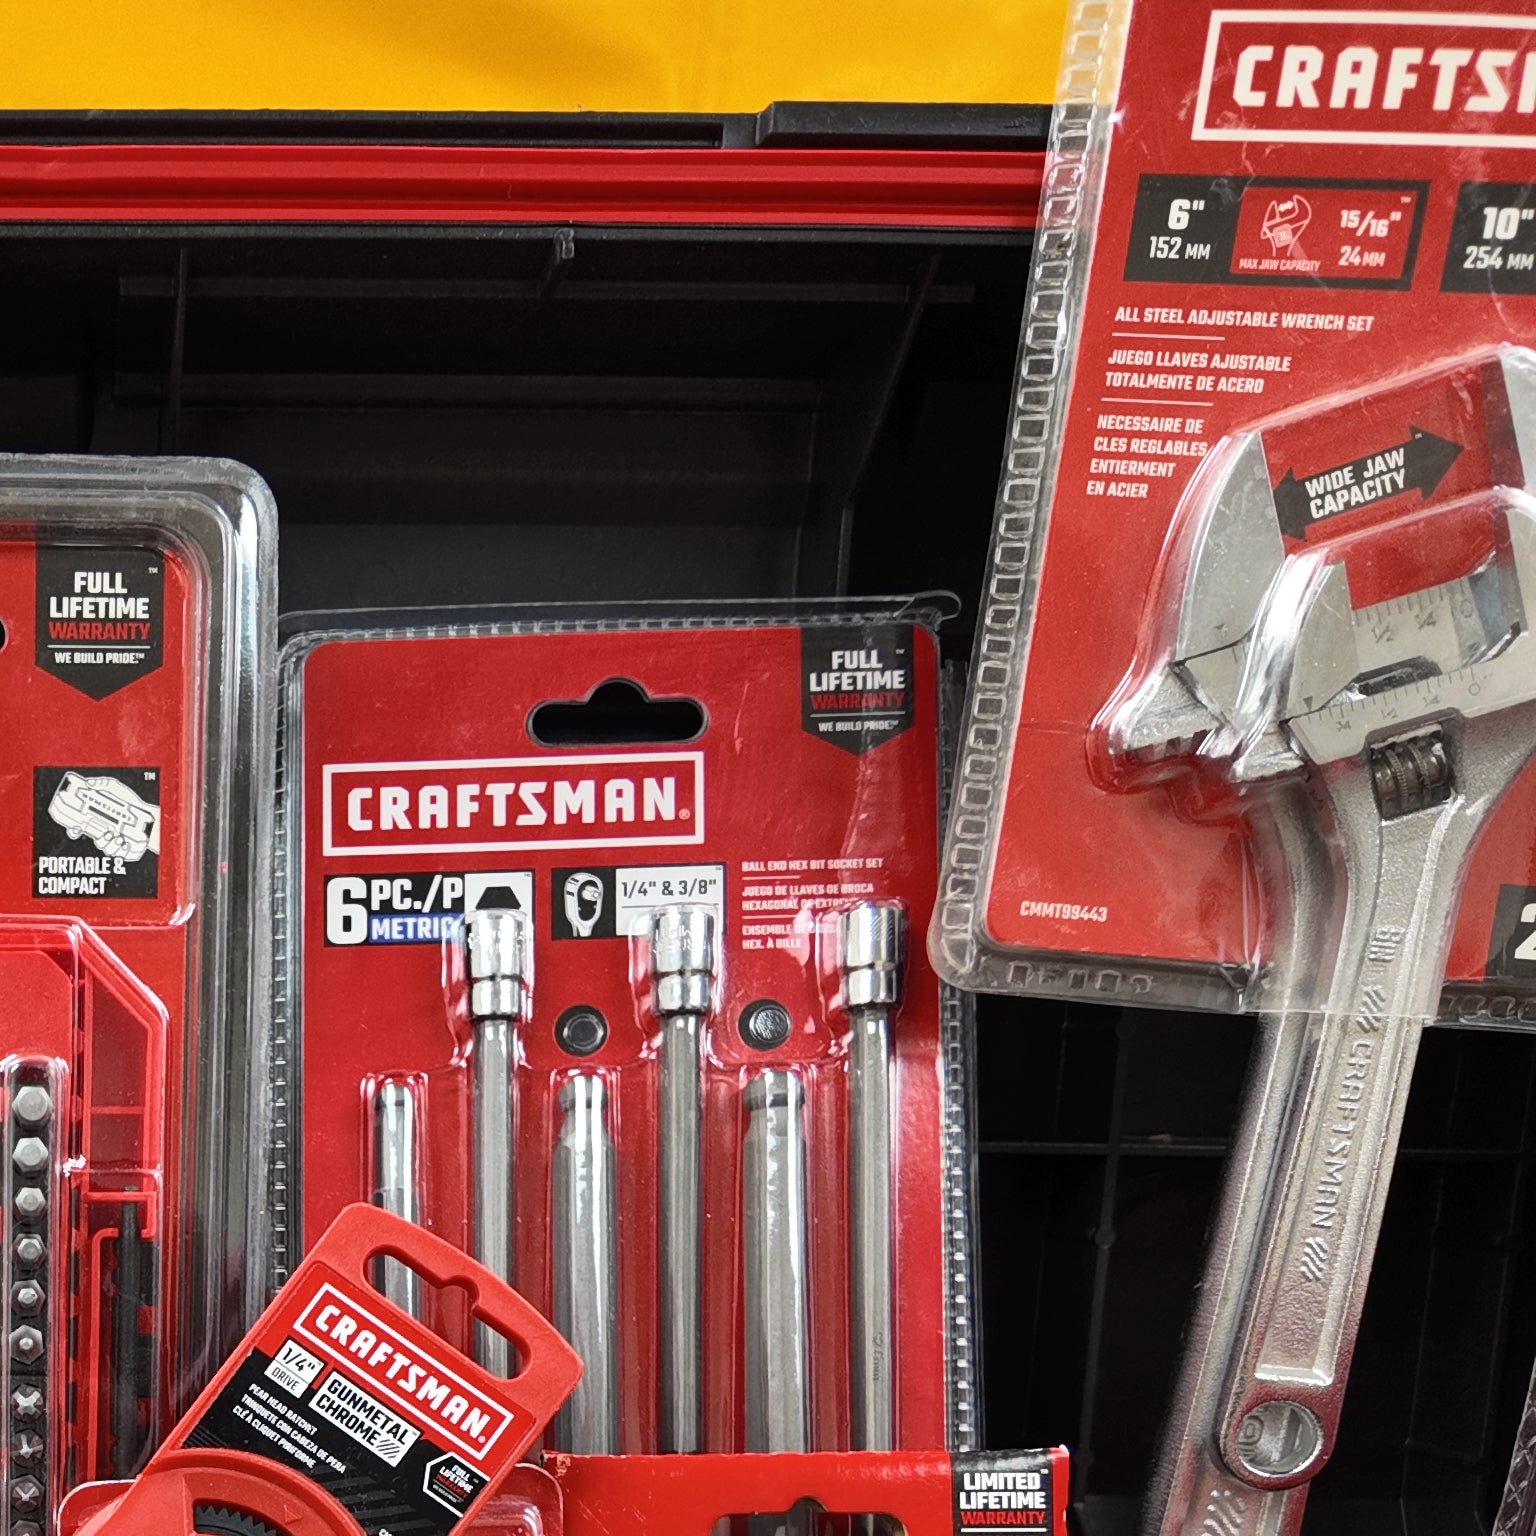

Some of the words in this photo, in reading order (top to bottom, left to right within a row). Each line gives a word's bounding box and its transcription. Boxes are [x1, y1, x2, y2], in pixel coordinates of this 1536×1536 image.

[1150, 237, 1180, 259] 152
[1186, 244, 1210, 260] MM
[1339, 246, 1361, 266] 24
[1363, 253, 1385, 267] MM
[1464, 246, 1503, 269] 254
[1508, 254, 1534, 270] MM
[1115, 306, 1140, 322] ALL
[1144, 308, 1184, 324] STEEL
[1187, 309, 1279, 327] ADJUSTABLE
[1282, 313, 1344, 330] WRENCH
[1347, 315, 1374, 331] SET
[1108, 350, 1153, 365] JUEGO
[1156, 352, 1208, 368] LLAVES
[1211, 353, 1291, 372] AJUSTABLE
[1106, 372, 1193, 389] TOTALMENTE
[1196, 375, 1214, 391] DE
[1217, 377, 1264, 394] ACERO
[1097, 415, 1181, 432] NECESSAIRE
[1185, 419, 1204, 434] DE
[1305, 465, 1354, 499] WIDE
[1362, 448, 1404, 480] JAW
[1310, 469, 1405, 520] CAPACITY
[74, 572, 127, 593] FULL
[50, 598, 149, 619] LIFETIME
[49, 622, 151, 640] WARRANTY
[832, 650, 883, 670] FULL
[810, 670, 905, 692] LIFETIME
[39, 857, 110, 874] PORTABLE
[113, 858, 126, 874] &
[742, 861, 766, 872] BALL
[768, 861, 786, 871] END
[789, 860, 808, 870] HEX
[810, 859, 825, 870] BIT
[828, 858, 863, 869] SOCKET
[866, 858, 884, 868] SET
[39, 877, 106, 894] COMPACT
[622, 881, 656, 897] 1/4"
[662, 881, 674, 896] &
[679, 879, 716, 896] 3/8"
[327, 876, 367, 944] 6
[1019, 900, 1108, 924] CMMT99443
[271, 1367, 299, 1391] DRIVE
[316, 1394, 378, 1445] CHROME
[328, 1379, 409, 1445] GUNMETAL
[964, 1472, 1041, 1490] LIMITED
[960, 1492, 1046, 1510] LIFETIME
[961, 1510, 1045, 1525] WARRANTY
